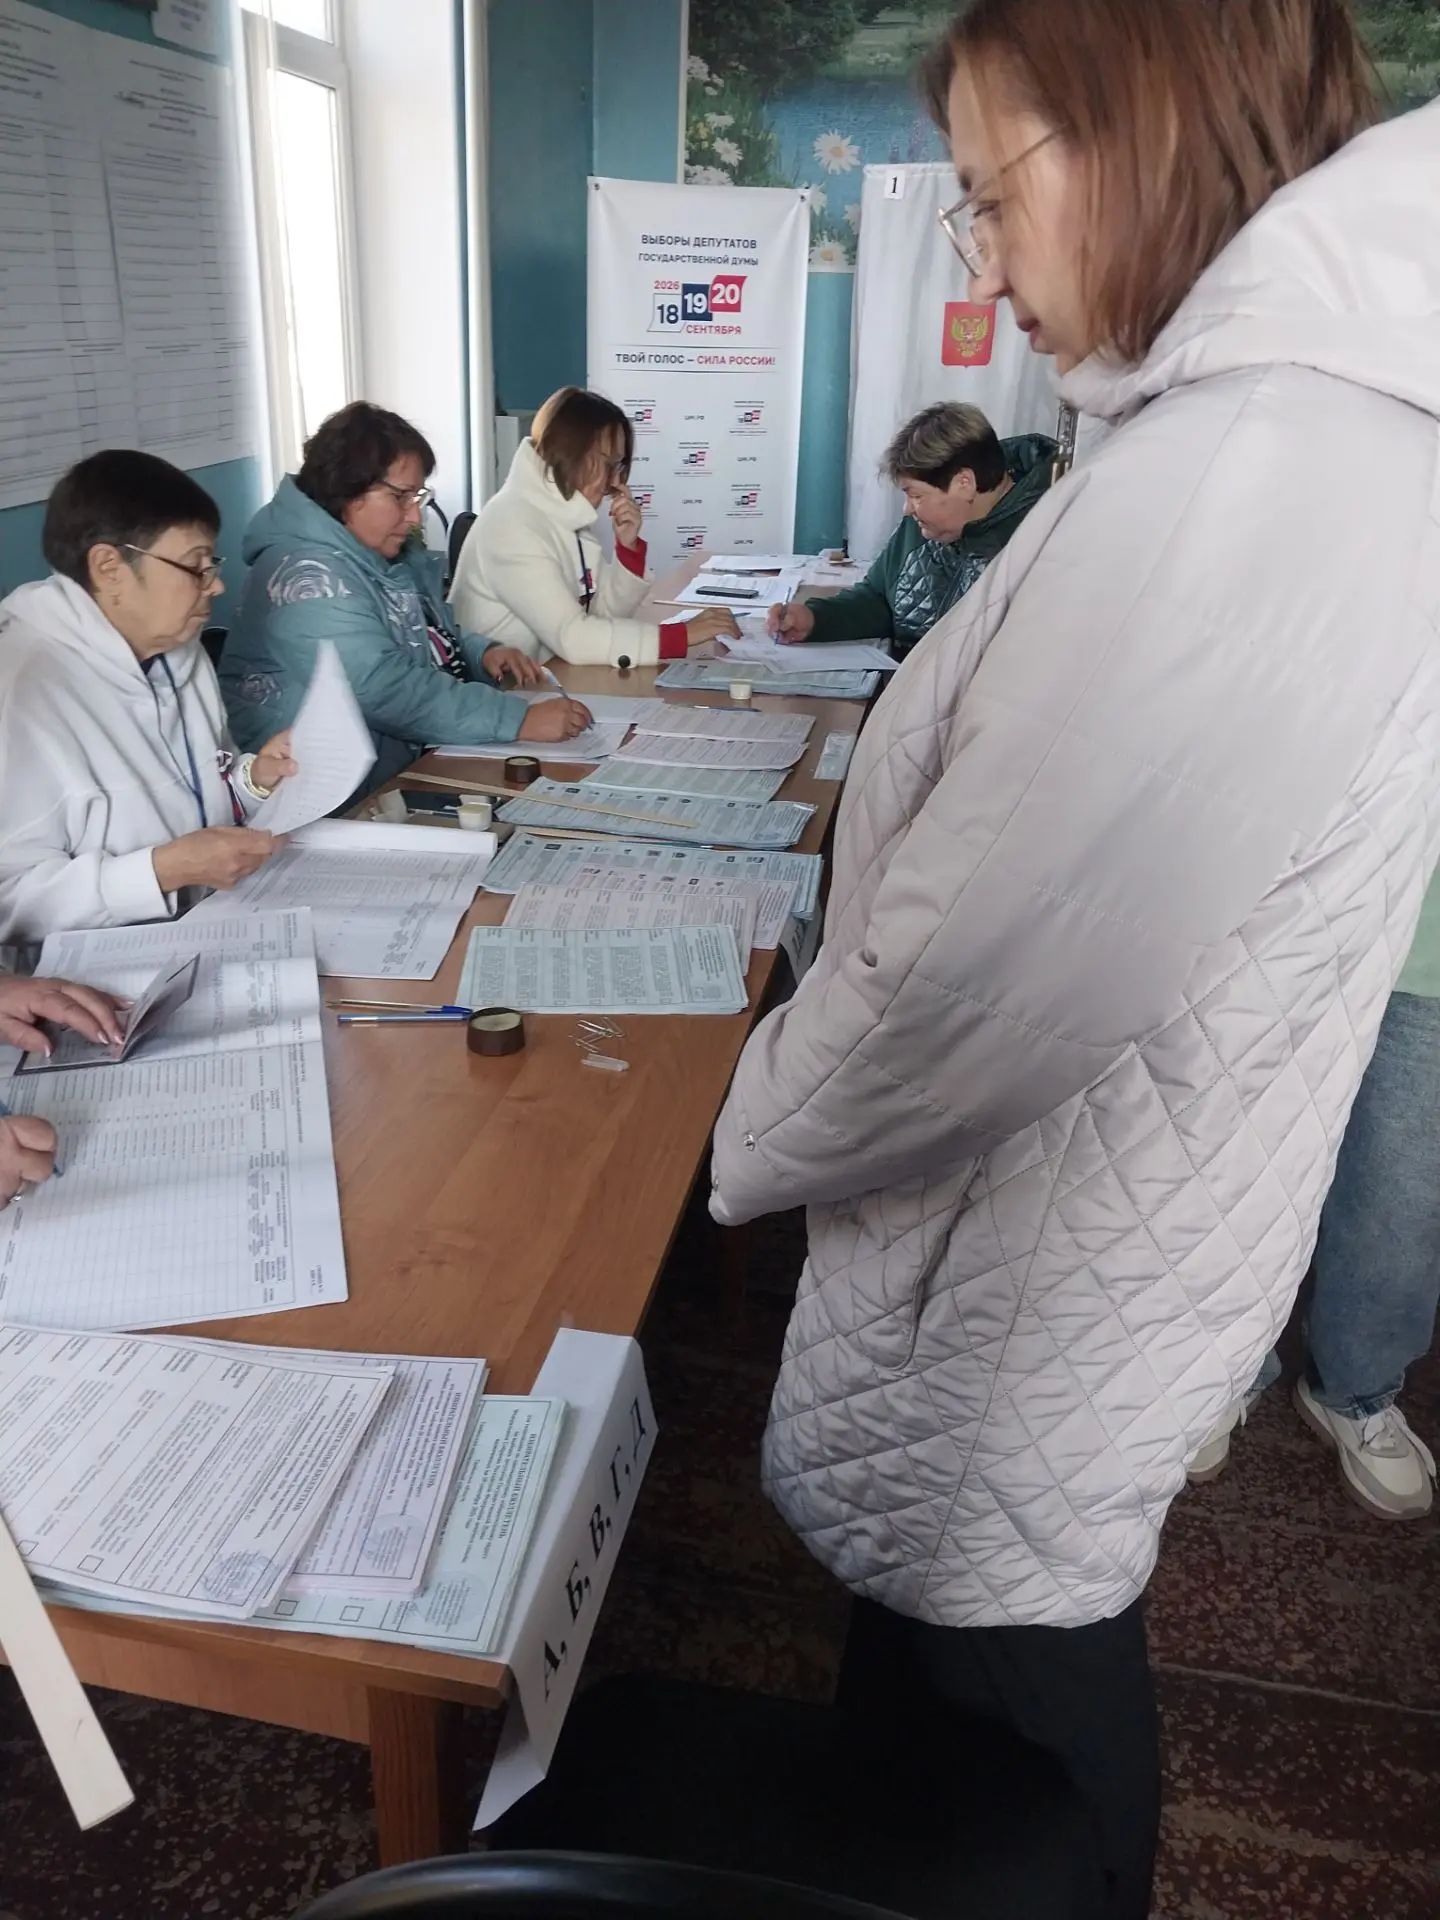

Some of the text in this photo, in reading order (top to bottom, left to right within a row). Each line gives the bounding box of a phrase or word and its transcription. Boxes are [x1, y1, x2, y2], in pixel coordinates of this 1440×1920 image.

[889, 175, 897, 194] 1
[641, 234, 757, 249] ВЫБОРЫ ДЕПУТАТОВ
[638, 252, 759, 266] ГОСУДАРСТВЕННОЙ ДУМЫ
[654, 280, 679, 290] 2026
[657, 283, 740, 324] 18 19 20
[686, 324, 741, 335] СЕНТЯБРЯ
[616, 352, 645, 364] ТВОЙ
[648, 354, 684, 366] ГОЛОС
[697, 356, 726, 366] СИЛА
[729, 356, 775, 366] РОССИИ!
